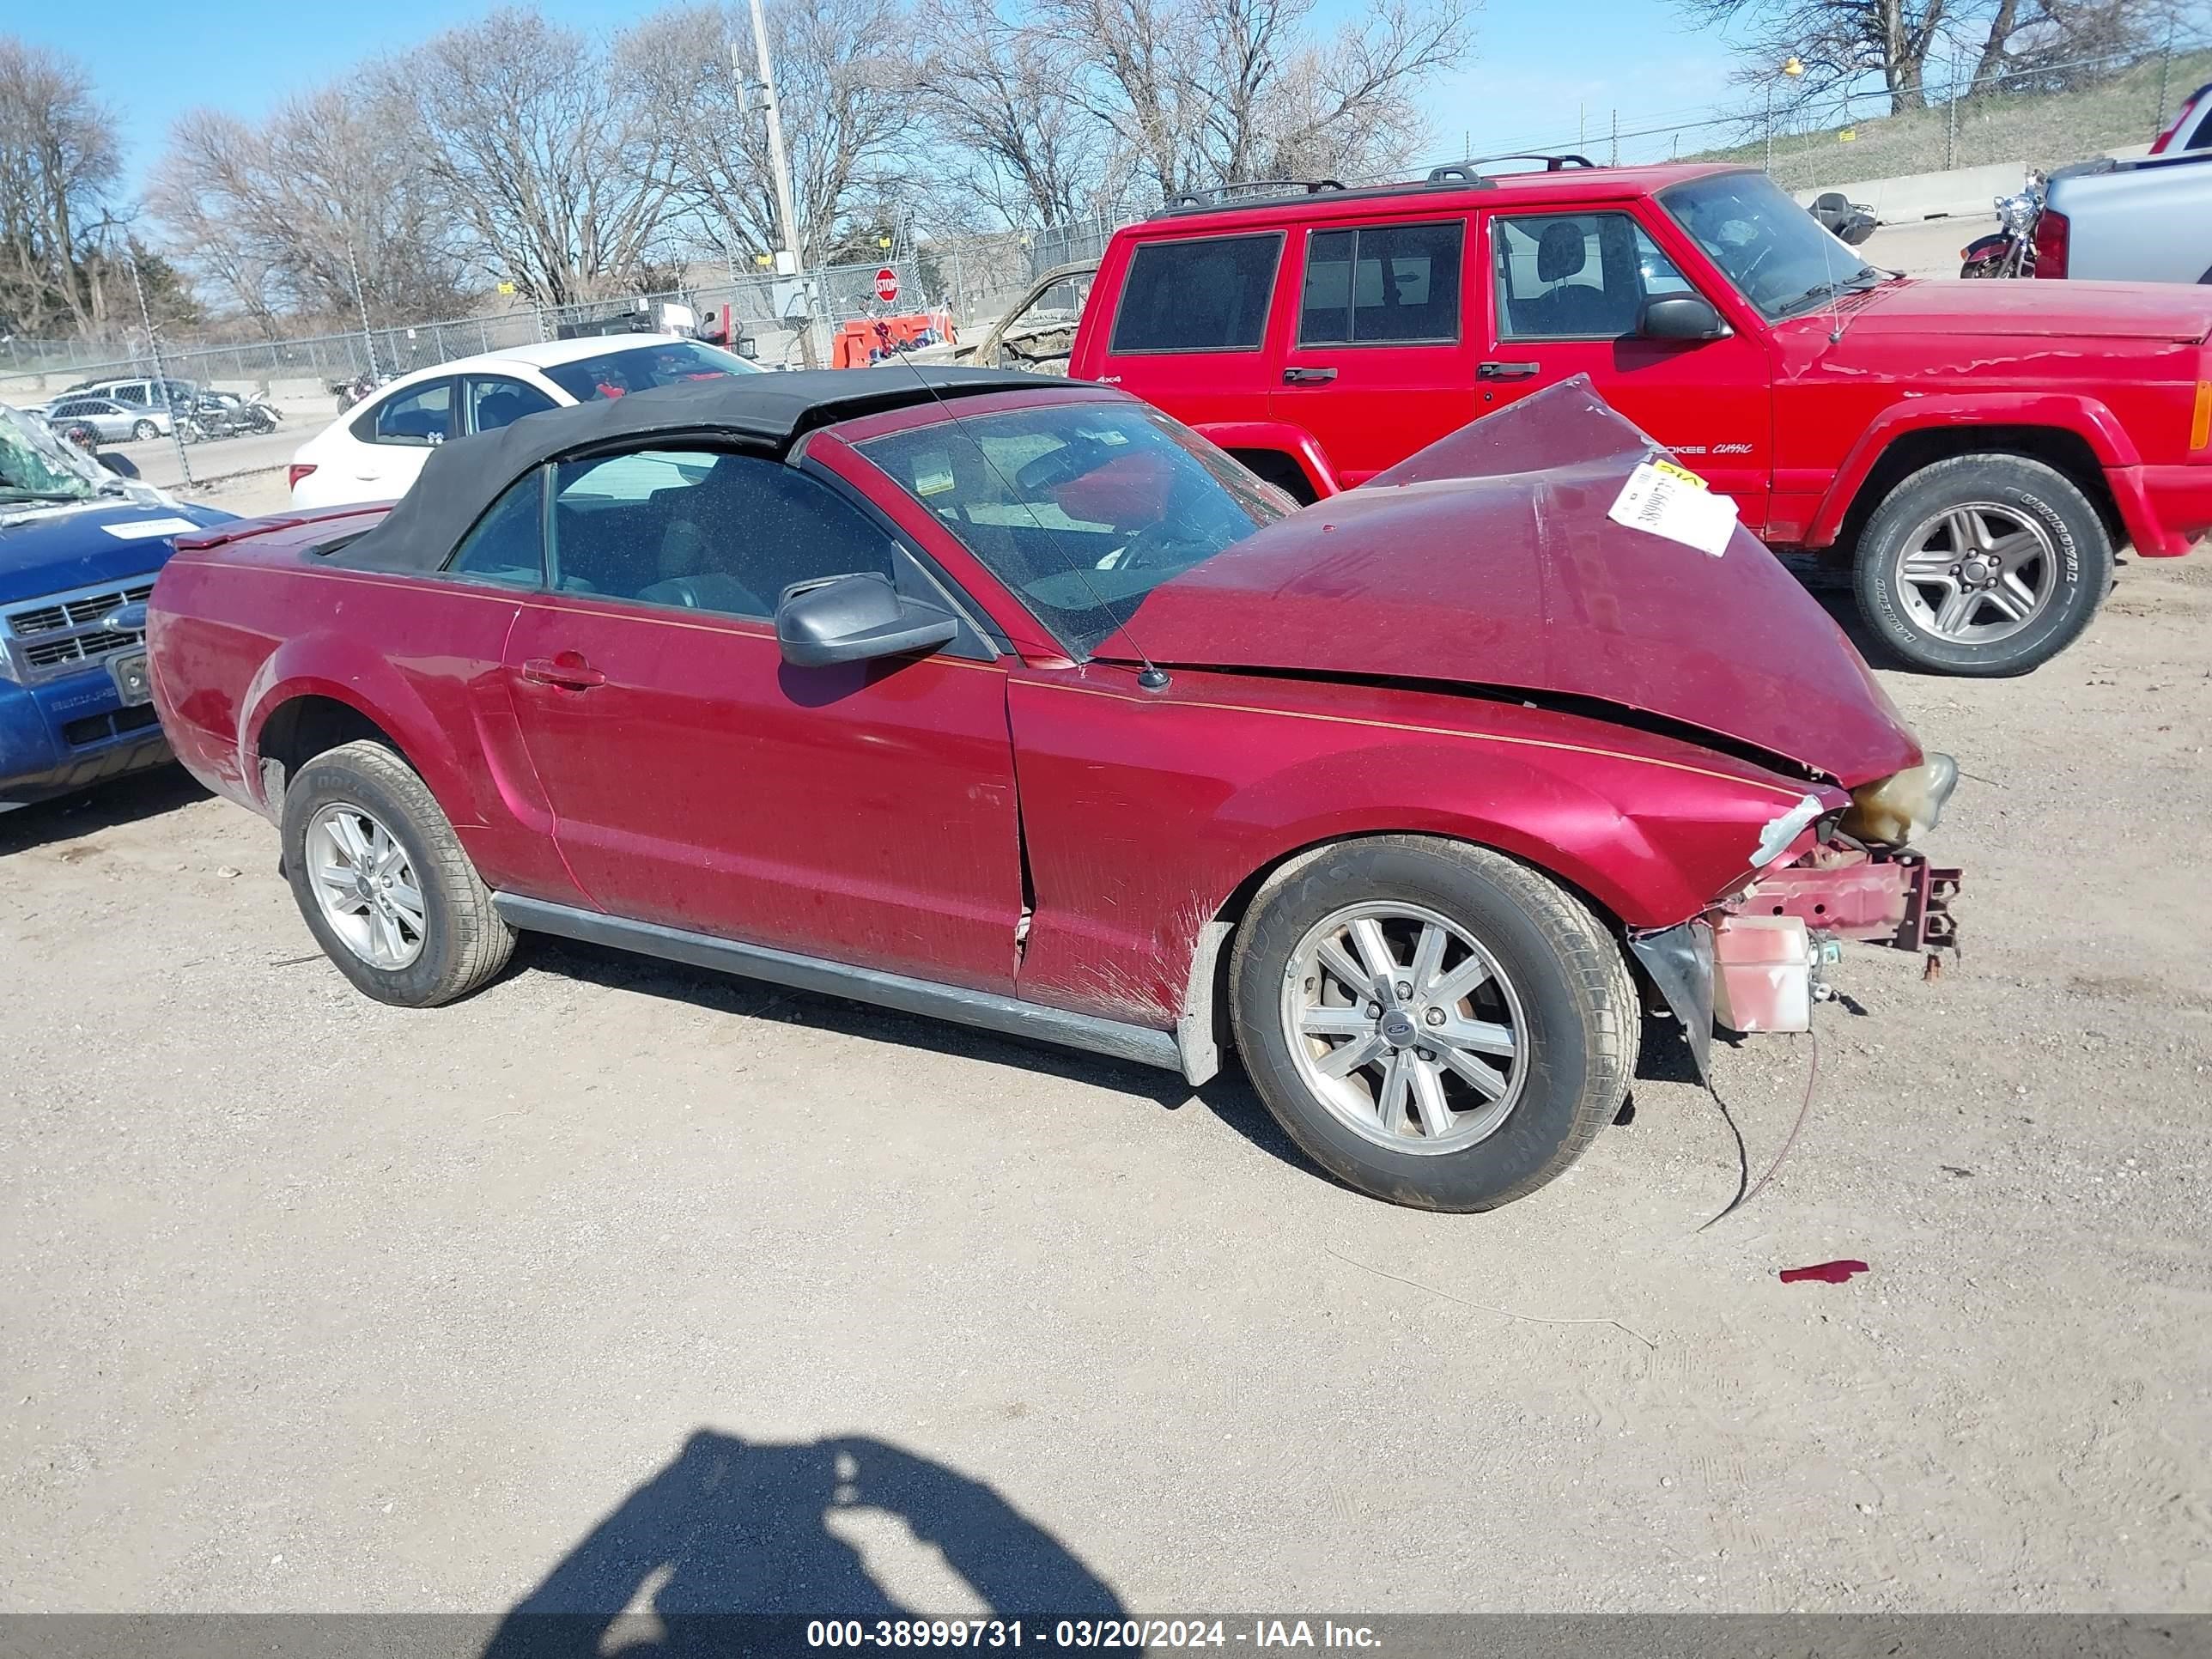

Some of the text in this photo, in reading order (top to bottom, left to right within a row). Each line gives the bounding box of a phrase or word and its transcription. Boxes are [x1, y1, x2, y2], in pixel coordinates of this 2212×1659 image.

[876, 278, 896, 292] STOP
[1711, 444, 1752, 453] CLASSIC
[2021, 493, 2078, 582] UNIROYAL
[1875, 578, 1917, 643] LAREDO
